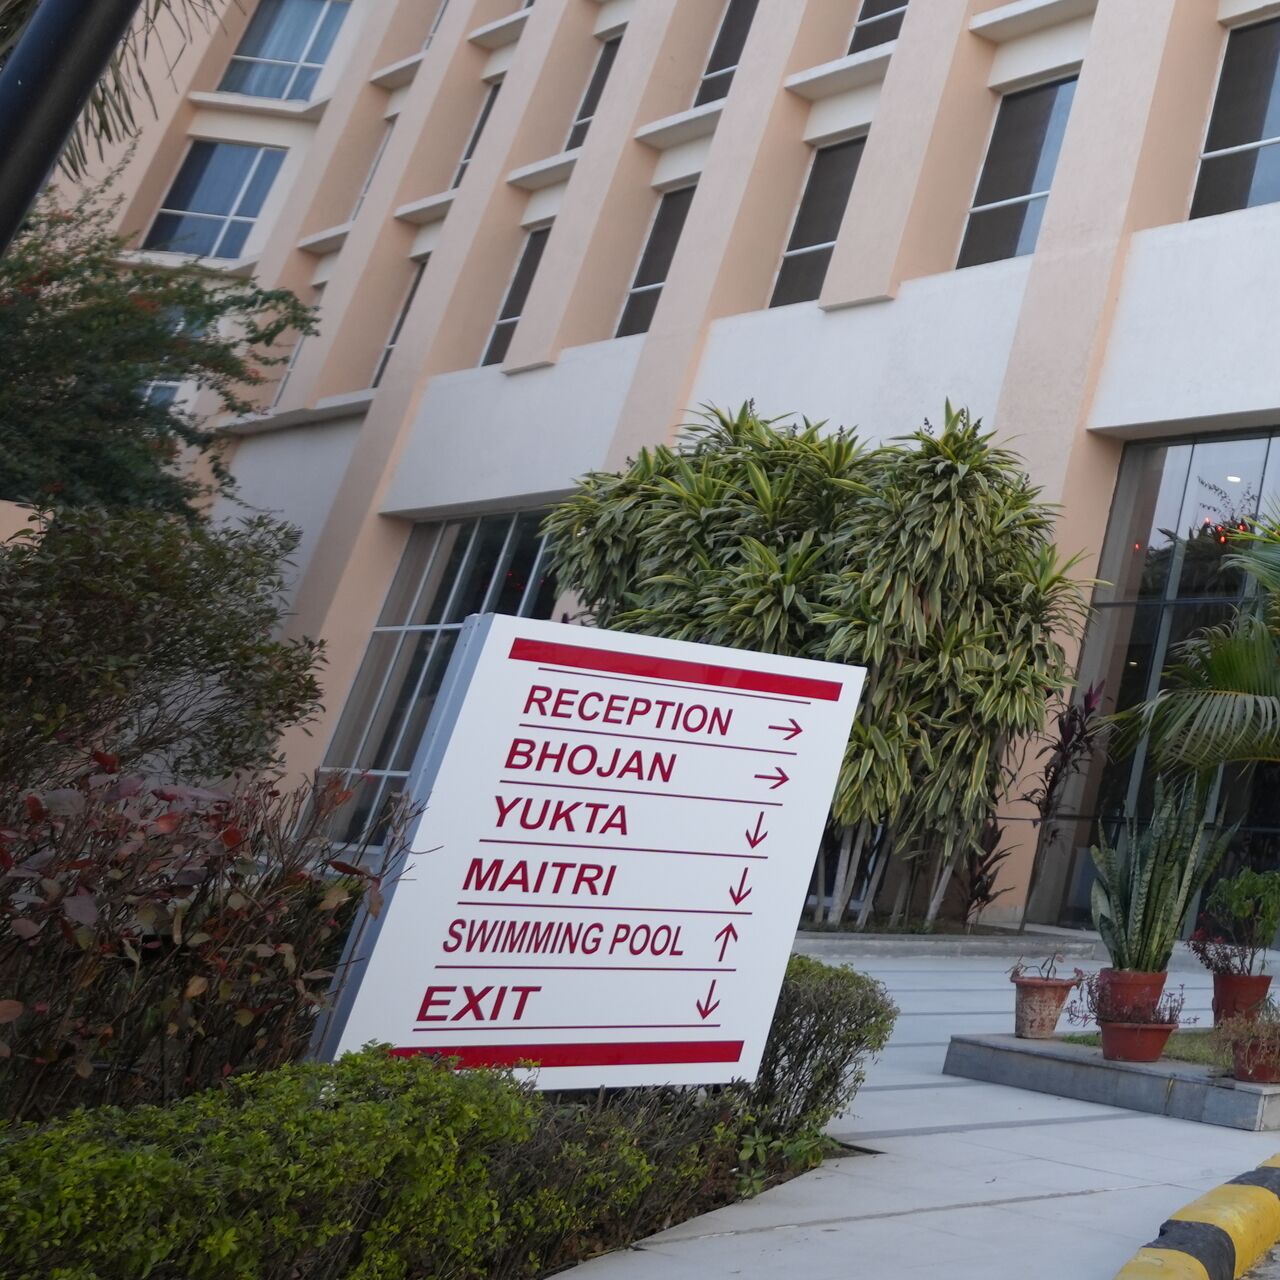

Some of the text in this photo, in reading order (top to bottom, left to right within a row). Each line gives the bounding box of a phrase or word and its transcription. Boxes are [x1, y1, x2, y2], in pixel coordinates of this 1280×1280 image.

[524, 686, 731, 735] RECEPTION
[505, 739, 675, 782] BHOJAN
[496, 797, 626, 834] YUKTA
[463, 859, 615, 895] MAITRI
[444, 919, 682, 955] SWIMMING POOL
[417, 987, 541, 1021] EXIT
